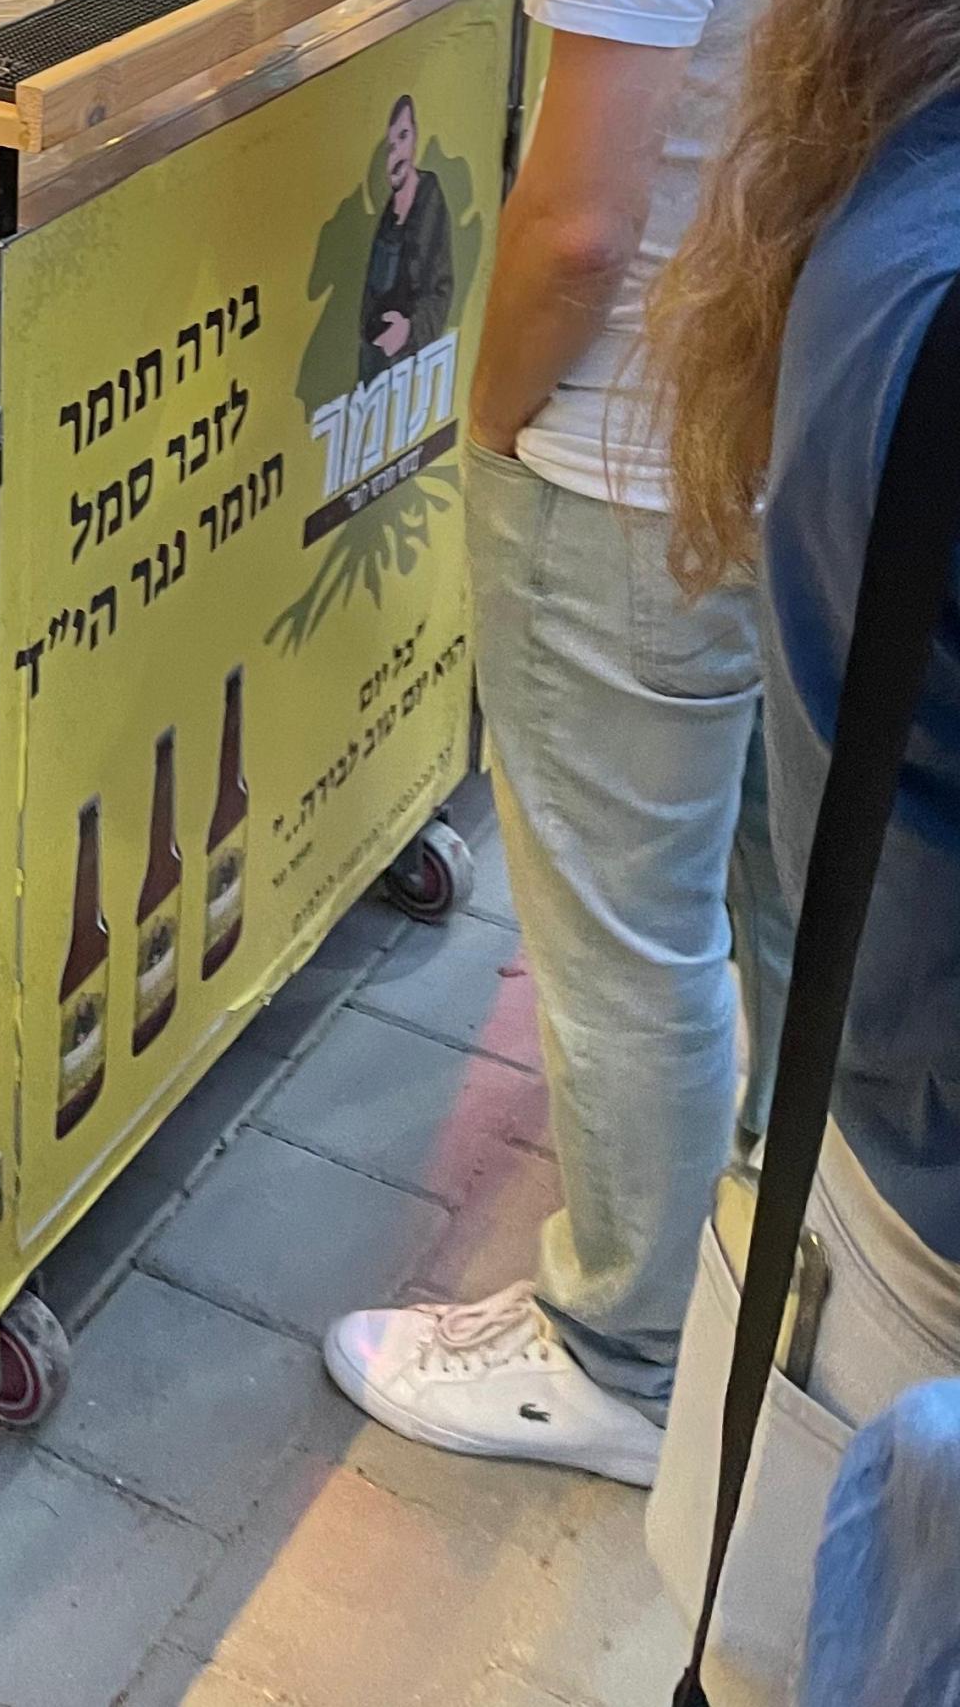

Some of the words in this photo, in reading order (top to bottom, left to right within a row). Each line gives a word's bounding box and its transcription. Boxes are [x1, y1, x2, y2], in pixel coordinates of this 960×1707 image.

[176, 284, 261, 385] בירה
[59, 348, 162, 455] תומר
[166, 379, 249, 483] לזכר
[311, 330, 458, 498] תומר
[71, 458, 153, 565] סמל
[199, 453, 284, 552] תומר
[131, 530, 186, 607] נגר
[360, 663, 388, 713] יום
